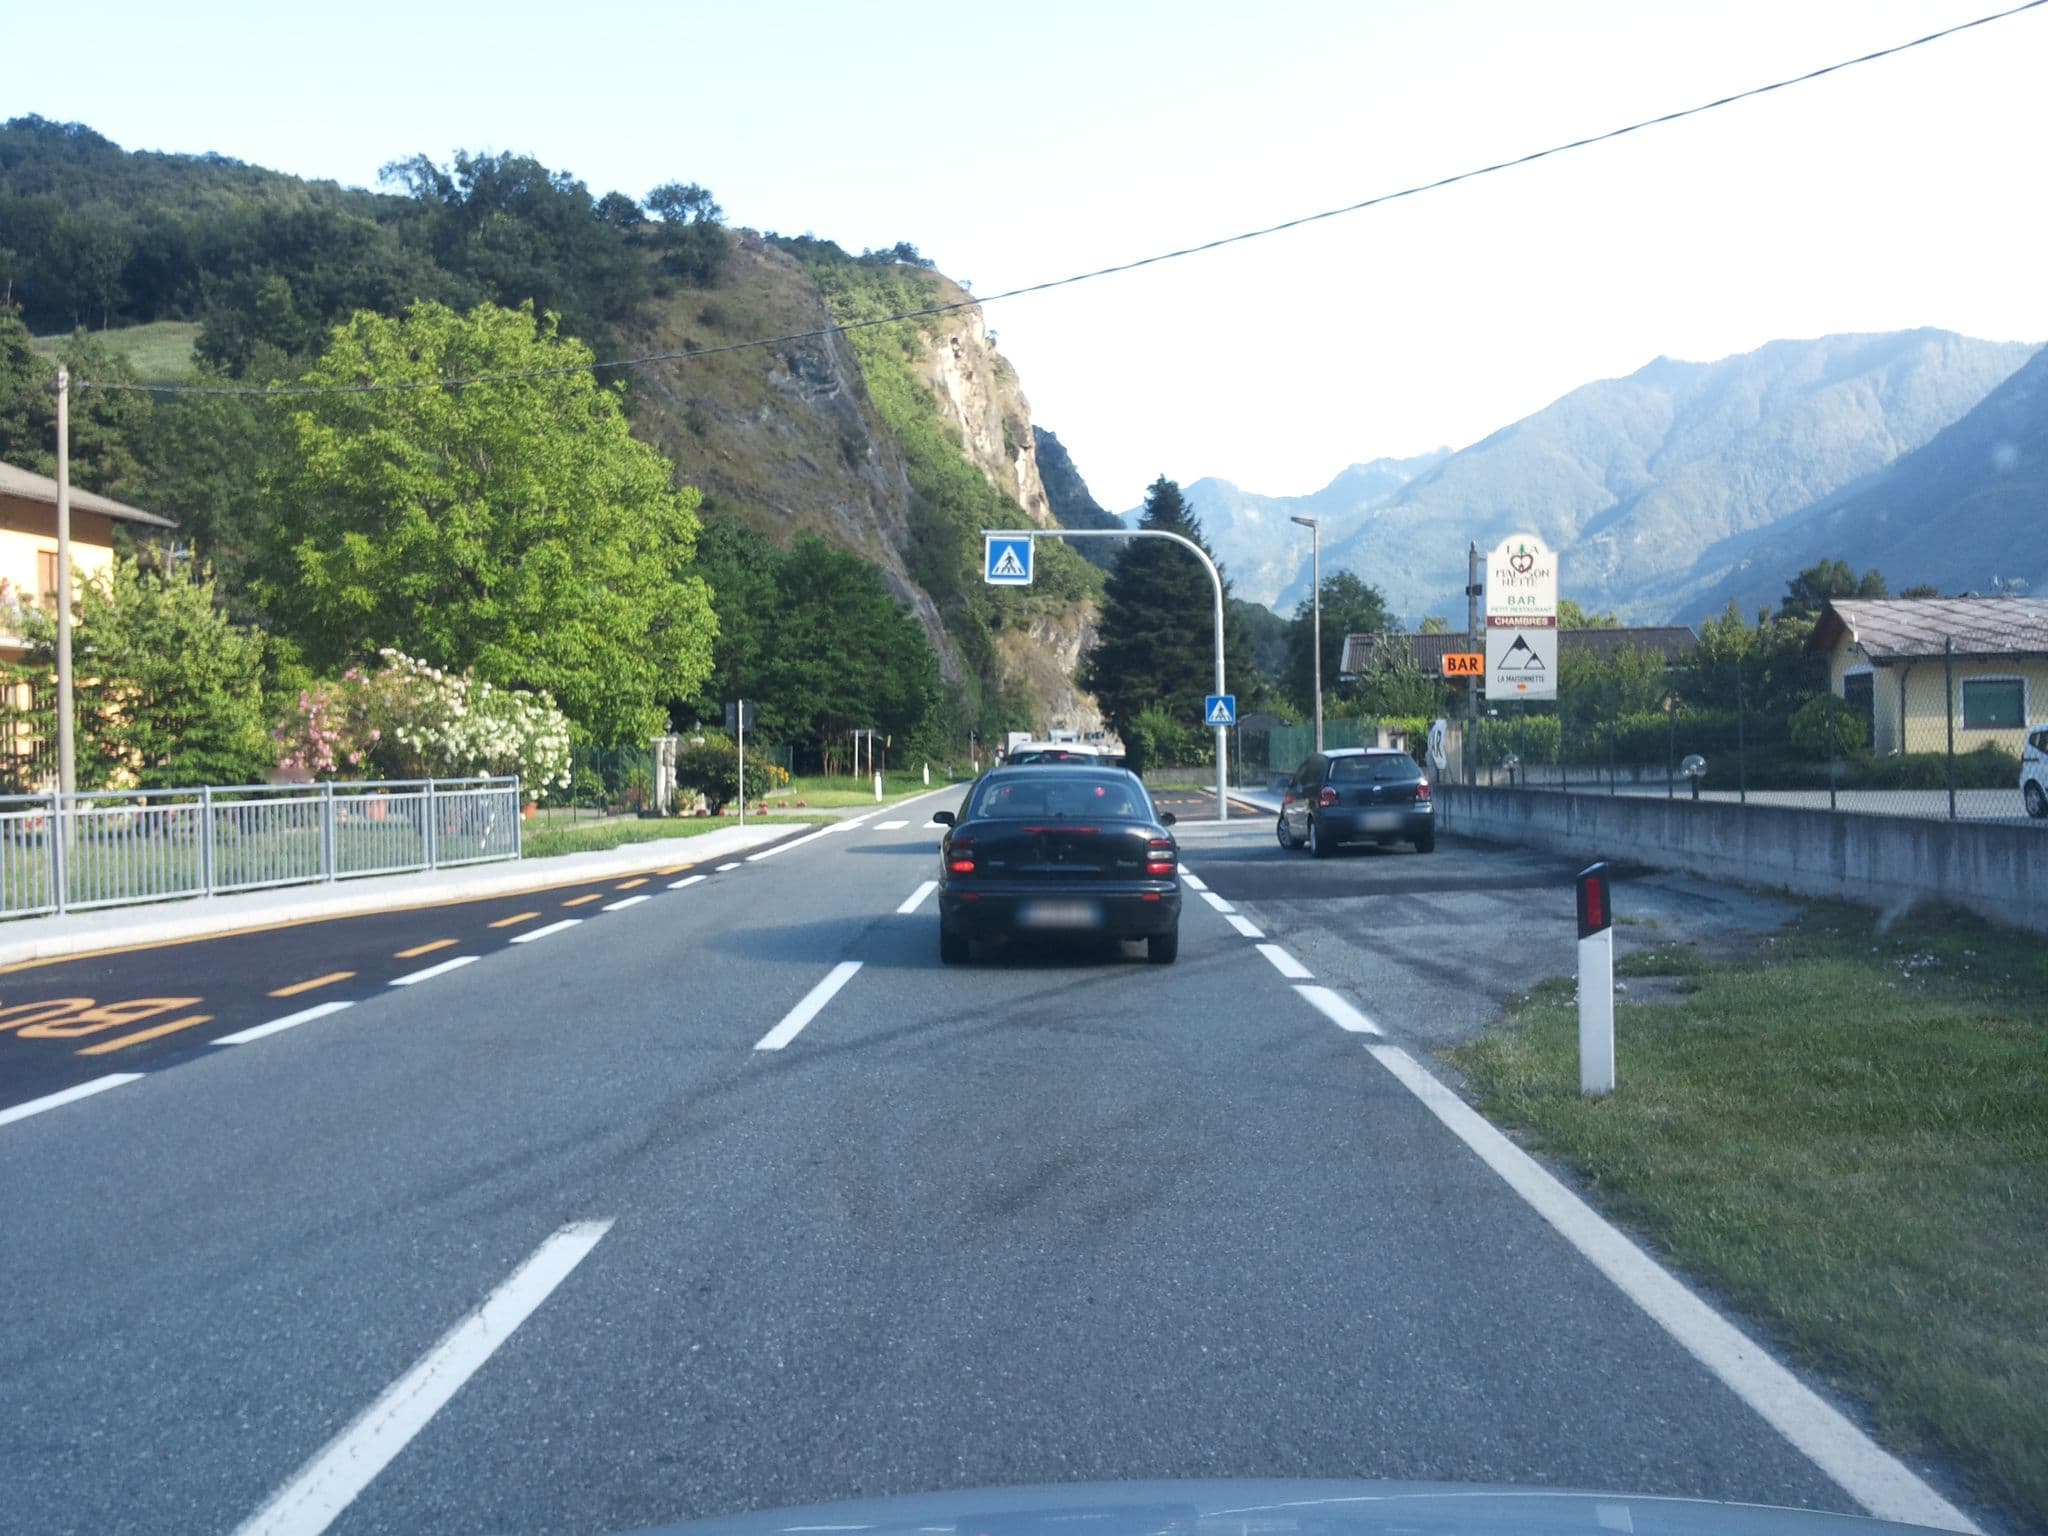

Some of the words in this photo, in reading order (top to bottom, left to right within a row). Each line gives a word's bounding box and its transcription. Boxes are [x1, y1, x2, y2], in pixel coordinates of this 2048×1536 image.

[1508, 595, 1537, 606] BAR
[1494, 617, 1548, 626] CHAMBRES
[1448, 658, 1478, 671] BAR
[1498, 674, 1505, 682] LA
